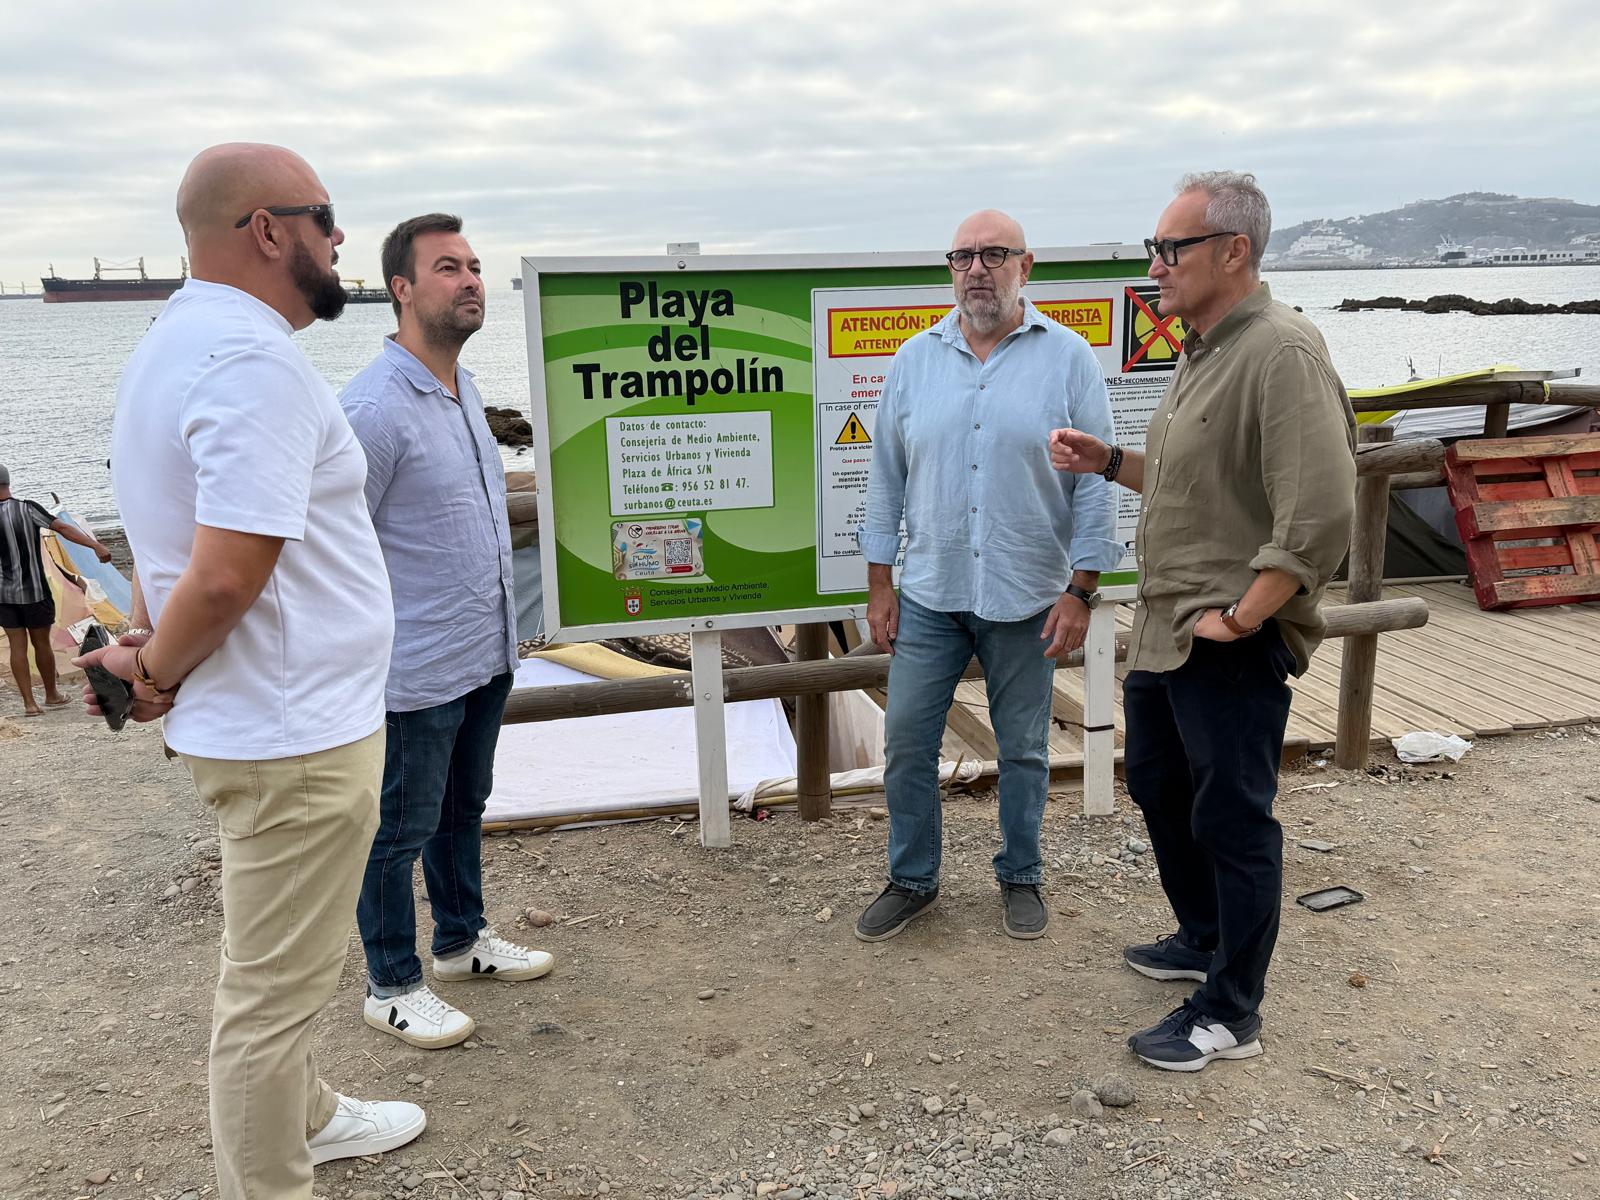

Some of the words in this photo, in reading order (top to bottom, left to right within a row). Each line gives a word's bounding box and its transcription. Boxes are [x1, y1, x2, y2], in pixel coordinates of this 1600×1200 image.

[619, 281, 735, 328] Playa
[840, 312, 925, 332] ATENCIÓN:
[648, 325, 711, 362] del
[854, 338, 909, 350] ATTENTI
[572, 357, 784, 406] Trampolín
[852, 374, 868, 384] En
[870, 375, 886, 384] ca
[851, 389, 882, 398] emer
[853, 402, 861, 410] of
[620, 421, 645, 432] Datos
[650, 420, 660, 430] de
[666, 419, 706, 429] contacto:
[671, 435, 682, 445] de
[687, 433, 712, 444] Medio
[716, 431, 760, 444] Ambiente,
[621, 451, 661, 463] Servicios
[665, 450, 701, 461] Urbanos
[705, 452, 711, 462] y
[714, 448, 751, 459] Vivienda
[622, 468, 646, 478] Plaza
[651, 466, 662, 477] de
[666, 463, 692, 476] África
[697, 464, 712, 474] S/N
[682, 481, 698, 491] 956
[704, 480, 714, 490] 52
[719, 478, 730, 489] 81
[735, 477, 750, 488] 47.
[694, 585, 704, 593] de
[706, 583, 729, 592] Medio
[650, 597, 686, 606] Servicios
[688, 595, 720, 604] Urbanos
[728, 592, 762, 600] Vivienda
